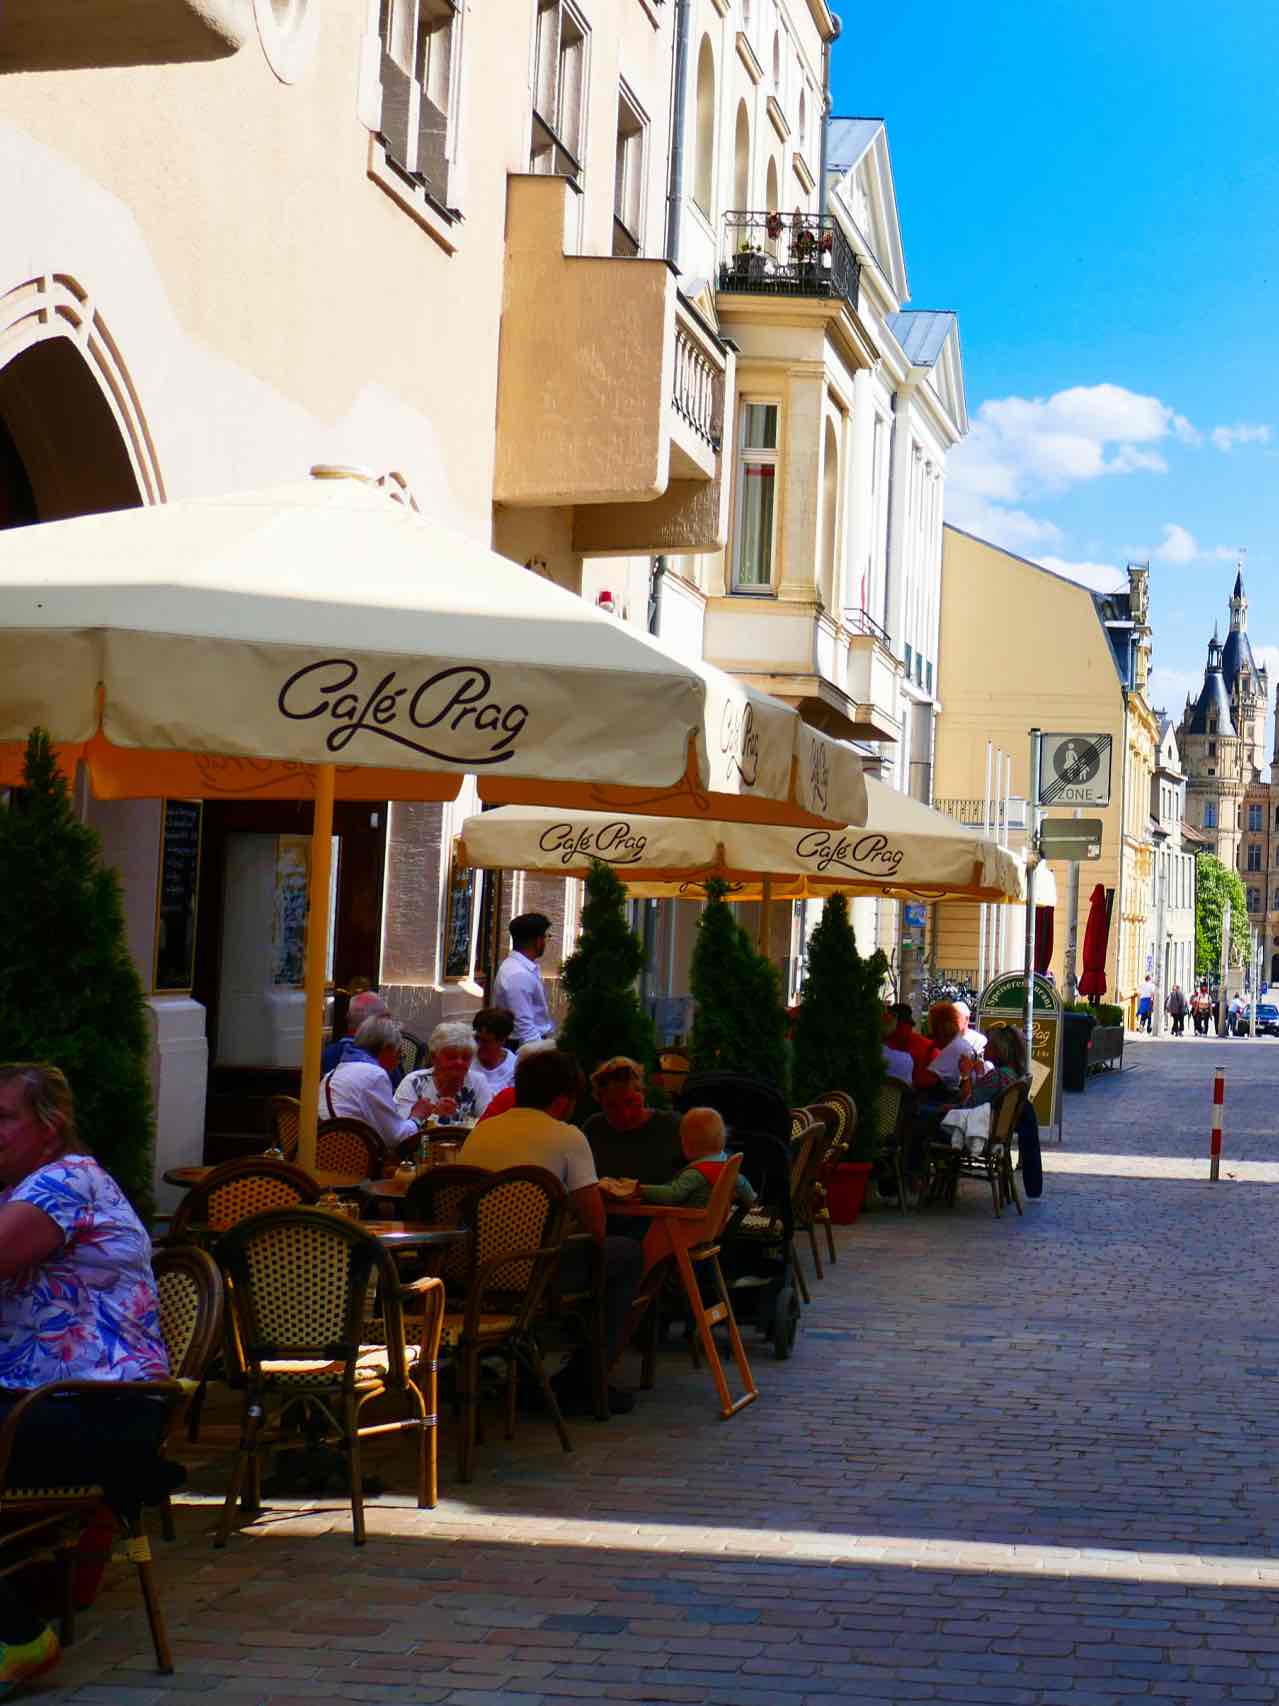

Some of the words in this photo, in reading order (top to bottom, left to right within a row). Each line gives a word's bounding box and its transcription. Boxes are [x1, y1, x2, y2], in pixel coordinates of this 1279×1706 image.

[278, 659, 407, 752] Café
[409, 666, 529, 751] Prag
[539, 823, 593, 864] Café
[595, 822, 647, 857] Prag
[796, 831, 850, 871] Café
[852, 834, 904, 872] Prag
